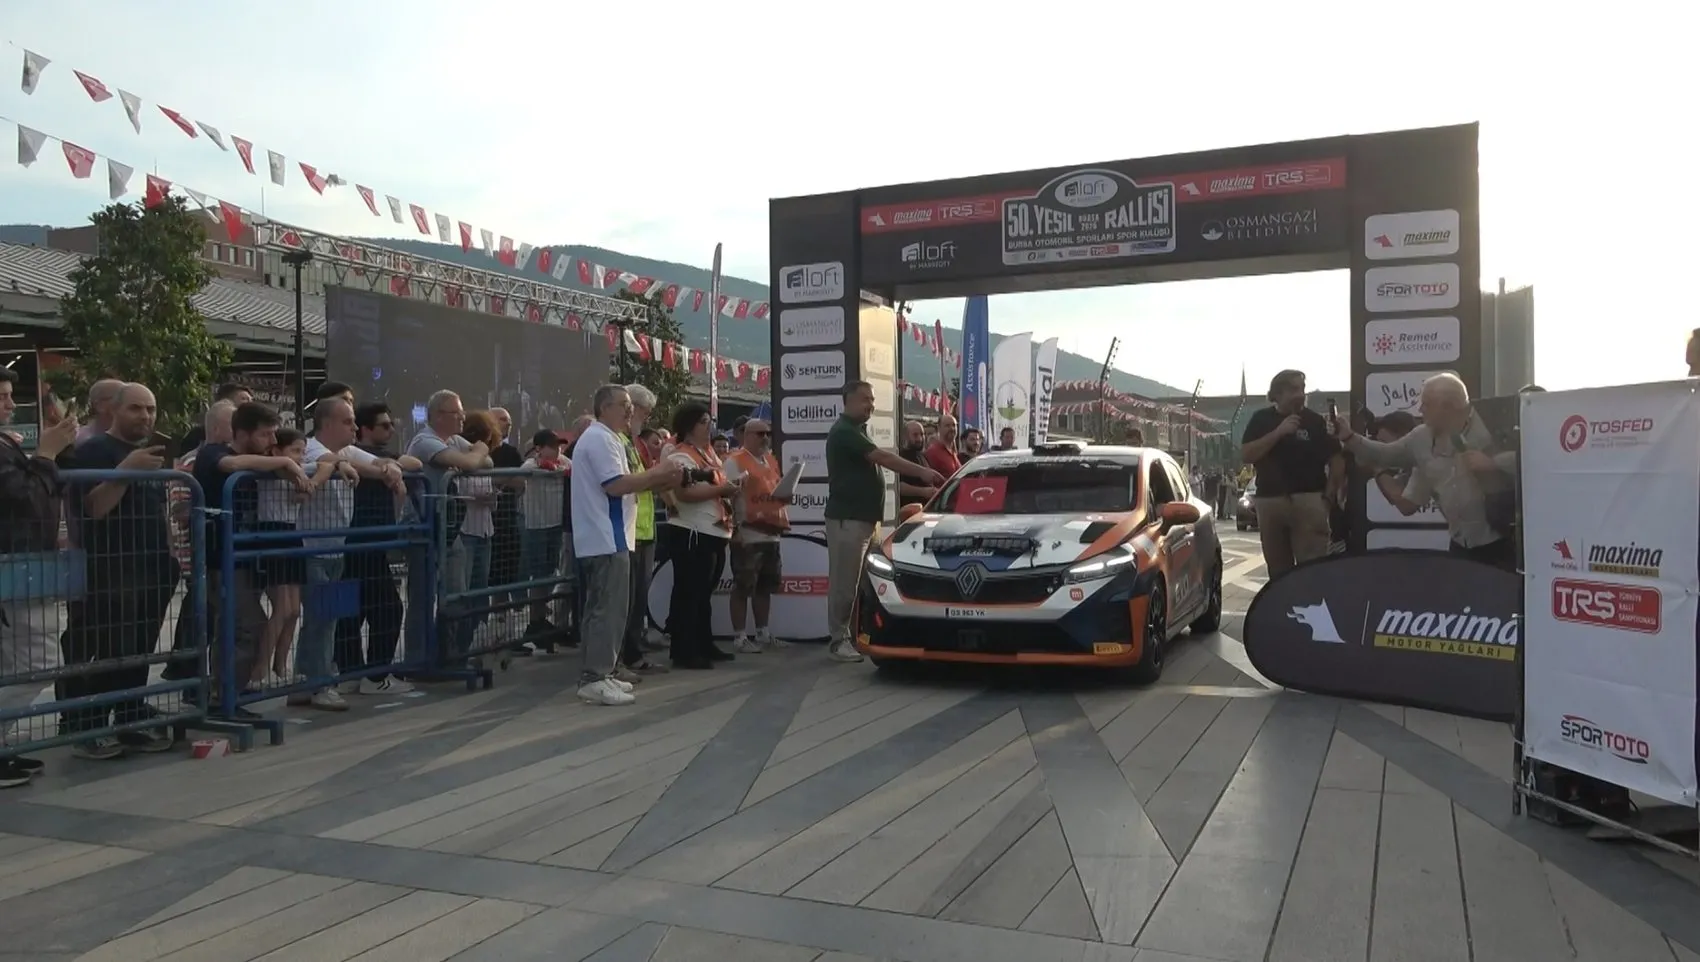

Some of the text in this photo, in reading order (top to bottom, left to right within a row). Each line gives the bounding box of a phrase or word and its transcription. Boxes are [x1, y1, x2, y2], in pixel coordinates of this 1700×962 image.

[1210, 174, 1256, 189] maxima
[1265, 170, 1303, 186] TRS
[893, 208, 933, 222] maxima
[940, 204, 973, 219] TRS
[1226, 208, 1317, 229] OSMANGAZİ
[1116, 230, 1137, 241] SPOR
[1403, 228, 1451, 243] maxima
[902, 239, 957, 262] aloft
[787, 267, 840, 289] aloft
[1399, 331, 1438, 343] Remed
[1399, 341, 1452, 353] Assistance
[1590, 418, 1653, 435] TOSFED
[1588, 541, 1663, 567] maxima
[1556, 586, 1616, 620] TRS
[1376, 606, 1518, 646] maxima
[1386, 636, 1501, 658] MOTOR YAĞLARI
